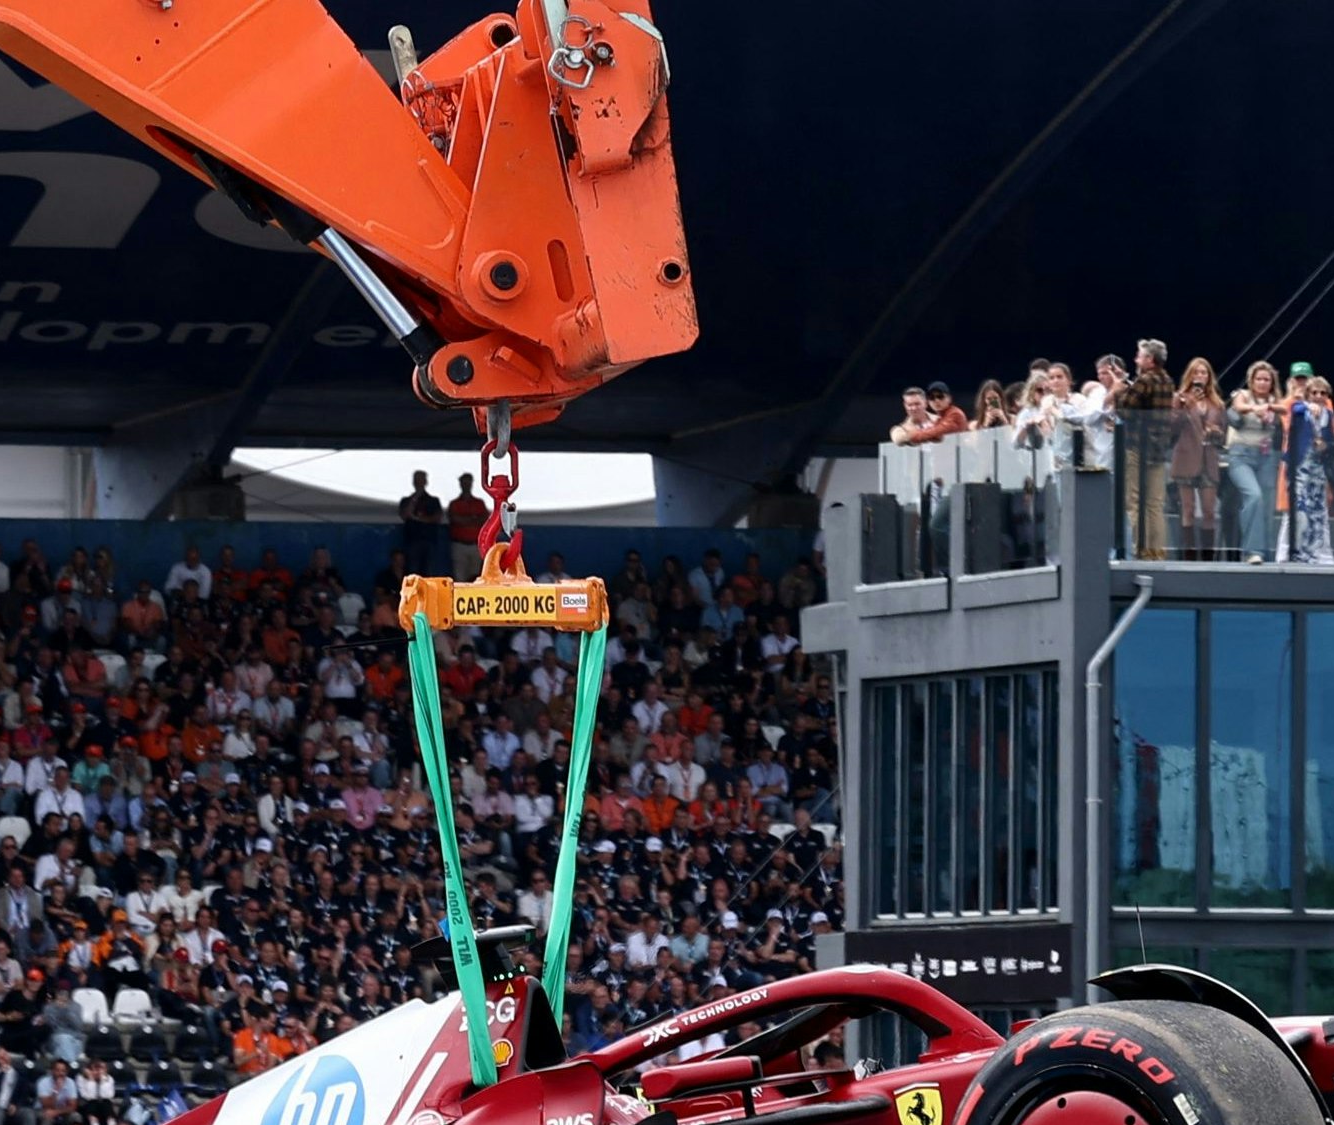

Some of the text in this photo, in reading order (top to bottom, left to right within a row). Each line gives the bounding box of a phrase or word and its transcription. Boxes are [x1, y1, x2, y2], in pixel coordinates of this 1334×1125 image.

[455, 595, 555, 616] CAP: 2000 KG
[640, 989, 769, 1047] DXC TECHNOLOGY
[1049, 1026, 1177, 1085] ZERO
